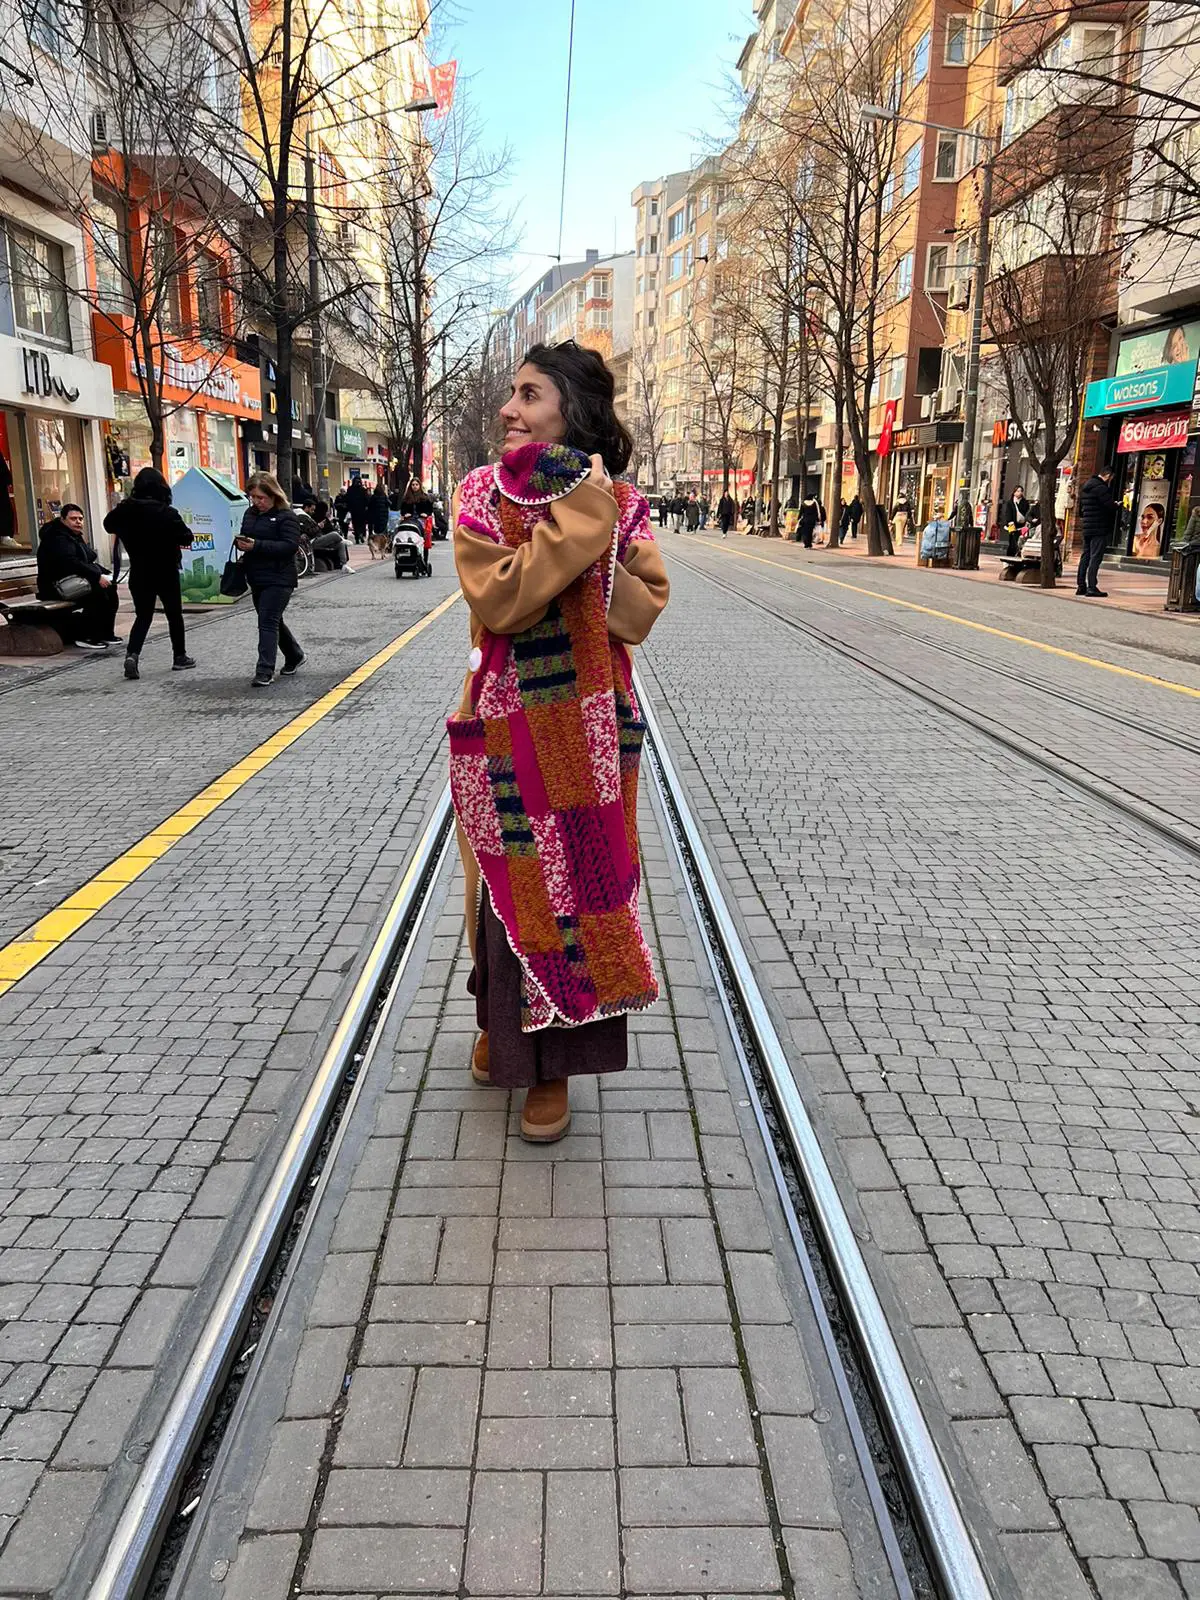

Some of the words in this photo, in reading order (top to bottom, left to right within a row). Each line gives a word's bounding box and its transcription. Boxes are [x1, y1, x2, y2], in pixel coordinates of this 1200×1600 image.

[22, 346, 53, 398] LTB
[1113, 379, 1159, 401] watsons
[992, 419, 1008, 448] IN
